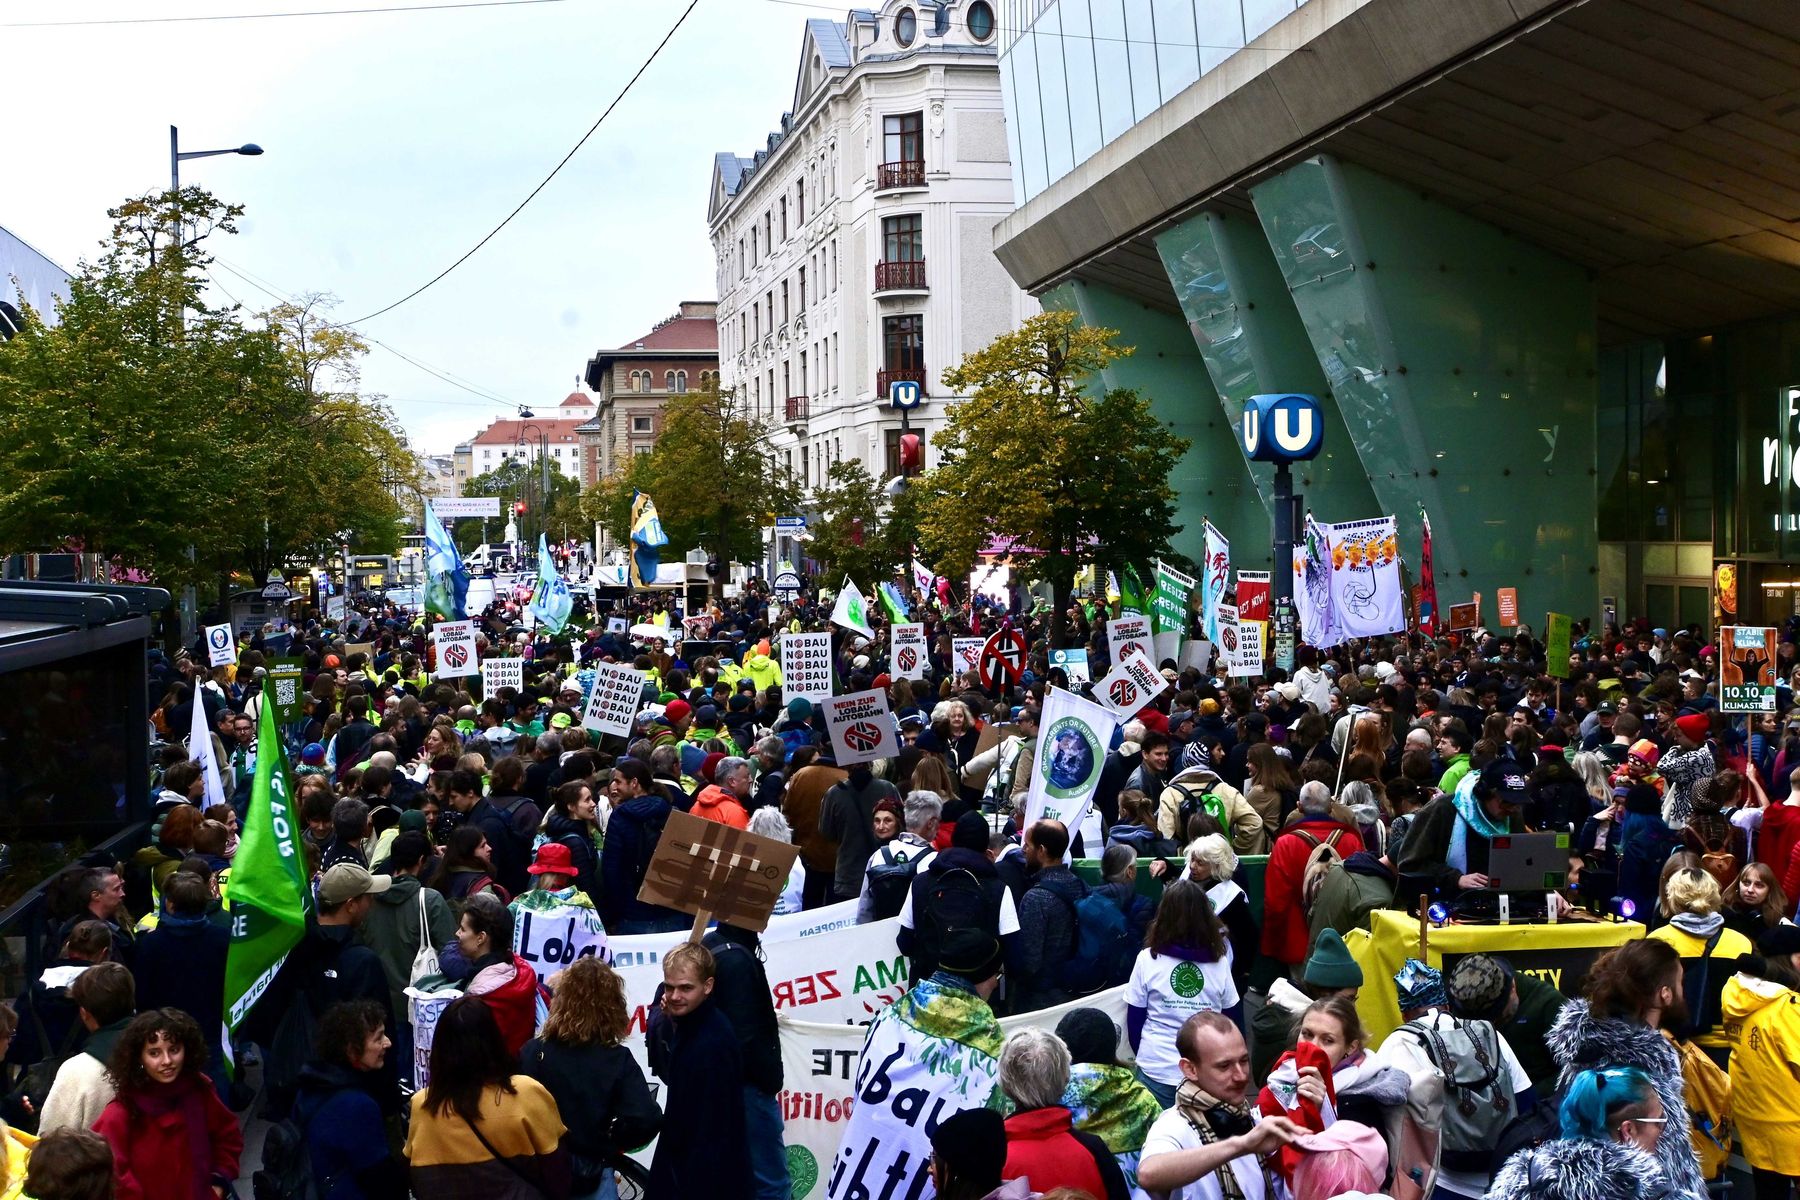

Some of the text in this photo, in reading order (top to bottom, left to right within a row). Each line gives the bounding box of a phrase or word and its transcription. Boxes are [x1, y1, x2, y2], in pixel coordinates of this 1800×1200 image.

[899, 386, 915, 405] U
[1244, 409, 1258, 453] U
[1274, 408, 1312, 451] U
[1160, 580, 1188, 602] RESIZE
[1158, 597, 1187, 619] REPAIR
[1158, 614, 1186, 635] REUSE
[439, 635, 470, 643] AUTOBAHN
[1113, 631, 1148, 641] AUTOBAHN
[1737, 639, 1764, 647] KLIMA.
[1124, 665, 1153, 696] AUTOBAHN
[1133, 665, 1152, 687] LOBAU-
[1136, 660, 1159, 686] NEIN ZUR
[1724, 687, 1763, 698] 10.10.
[833, 696, 876, 710] NEIN ZUR
[839, 704, 874, 716] LOBAU-
[1724, 702, 1763, 710] KLIMASTR
[833, 708, 884, 723] AUTOBAHN
[1079, 723, 1099, 749] FUTURE
[1068, 784, 1089, 797] Austria
[1043, 806, 1062, 821] Für
[1190, 963, 1203, 980] FUTURE
[1182, 987, 1200, 997] AUSTRIA
